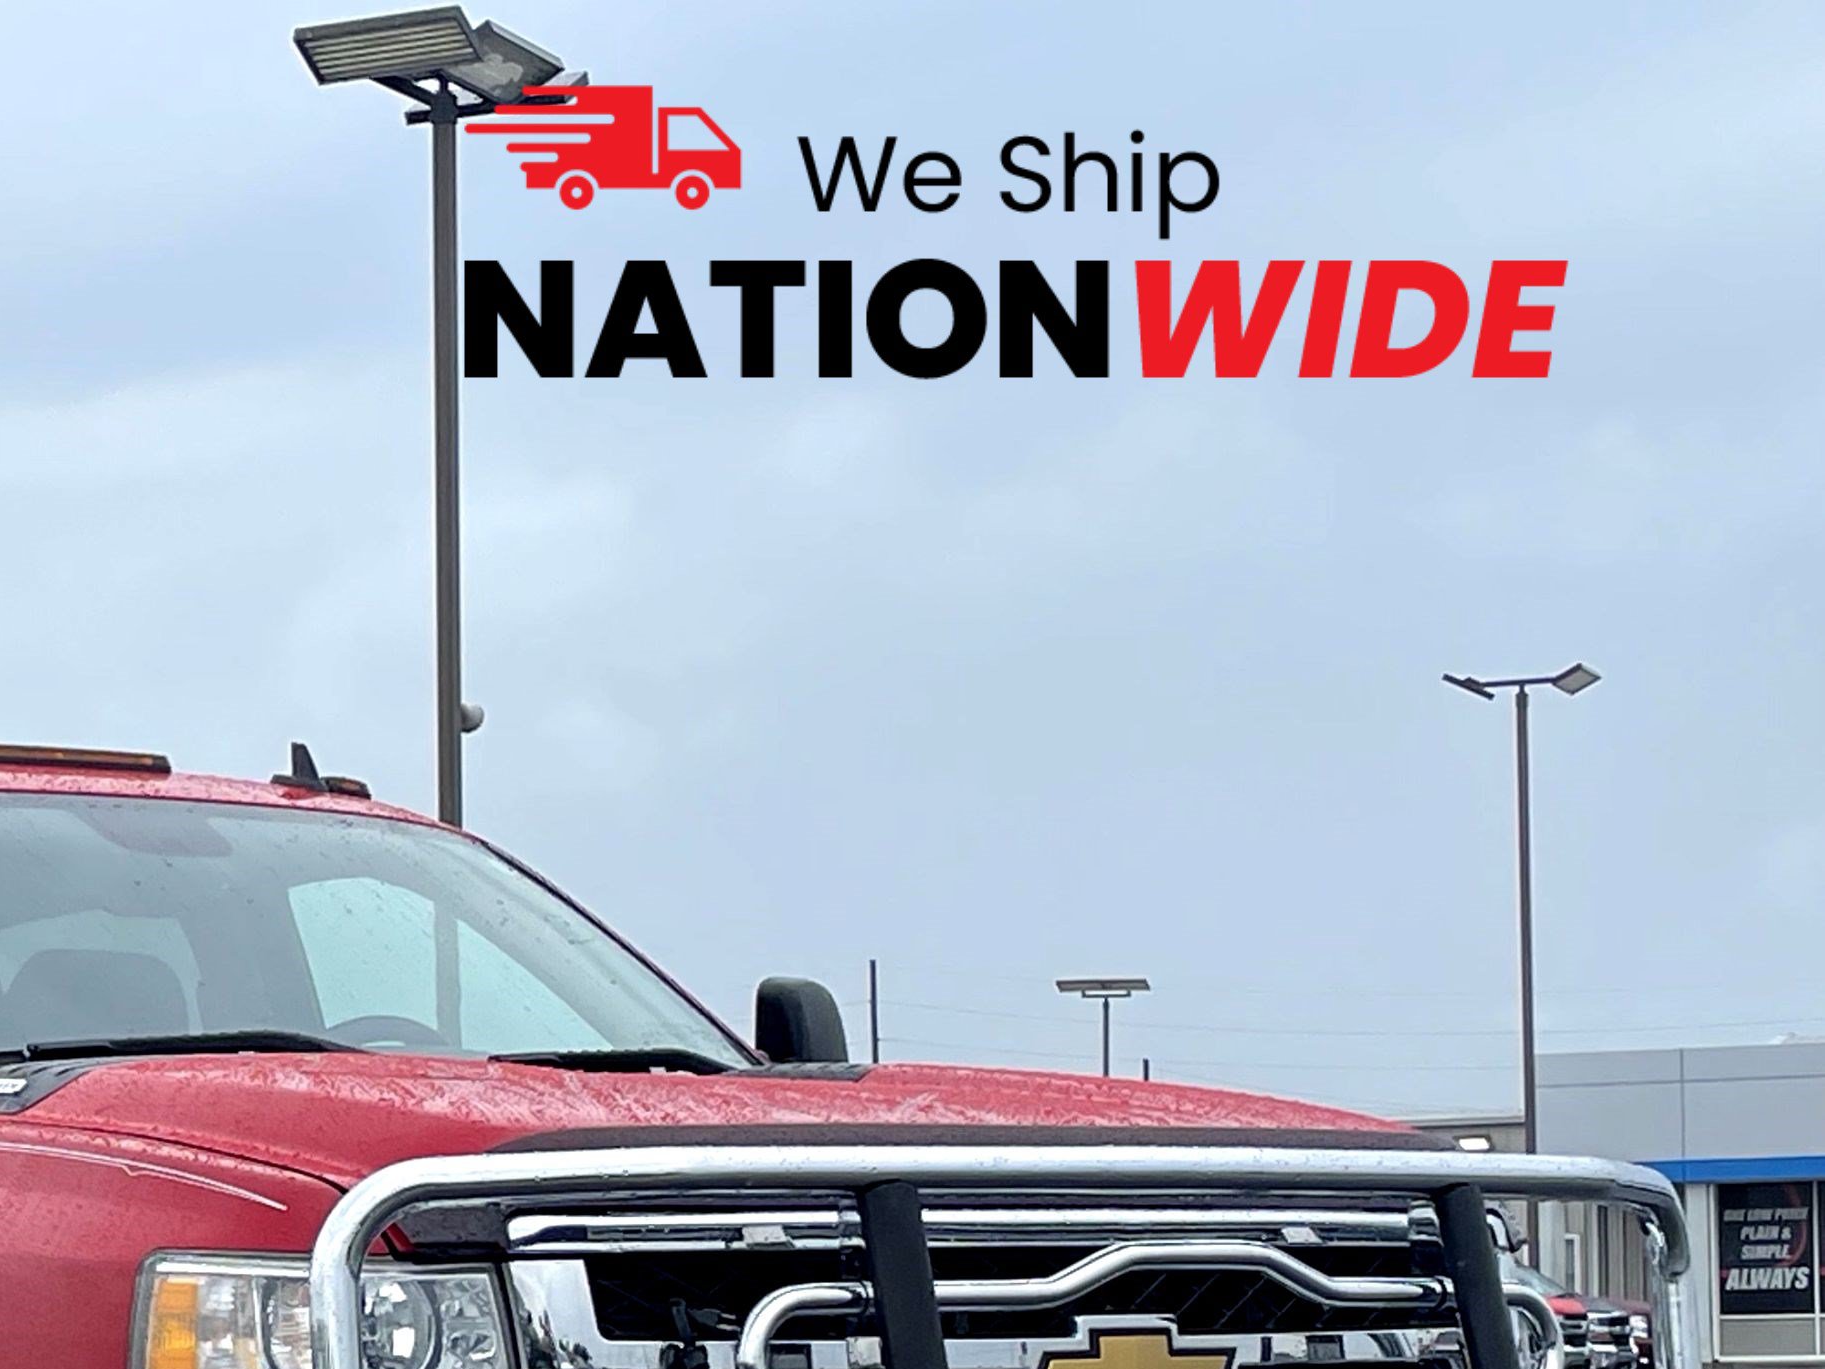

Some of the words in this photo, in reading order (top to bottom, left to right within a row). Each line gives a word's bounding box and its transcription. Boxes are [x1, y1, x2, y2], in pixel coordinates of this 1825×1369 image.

[1740, 1225, 1780, 1240] PLAIN
[1780, 1226, 1792, 1240] &
[1725, 1266, 1810, 1290] ALWAYS
